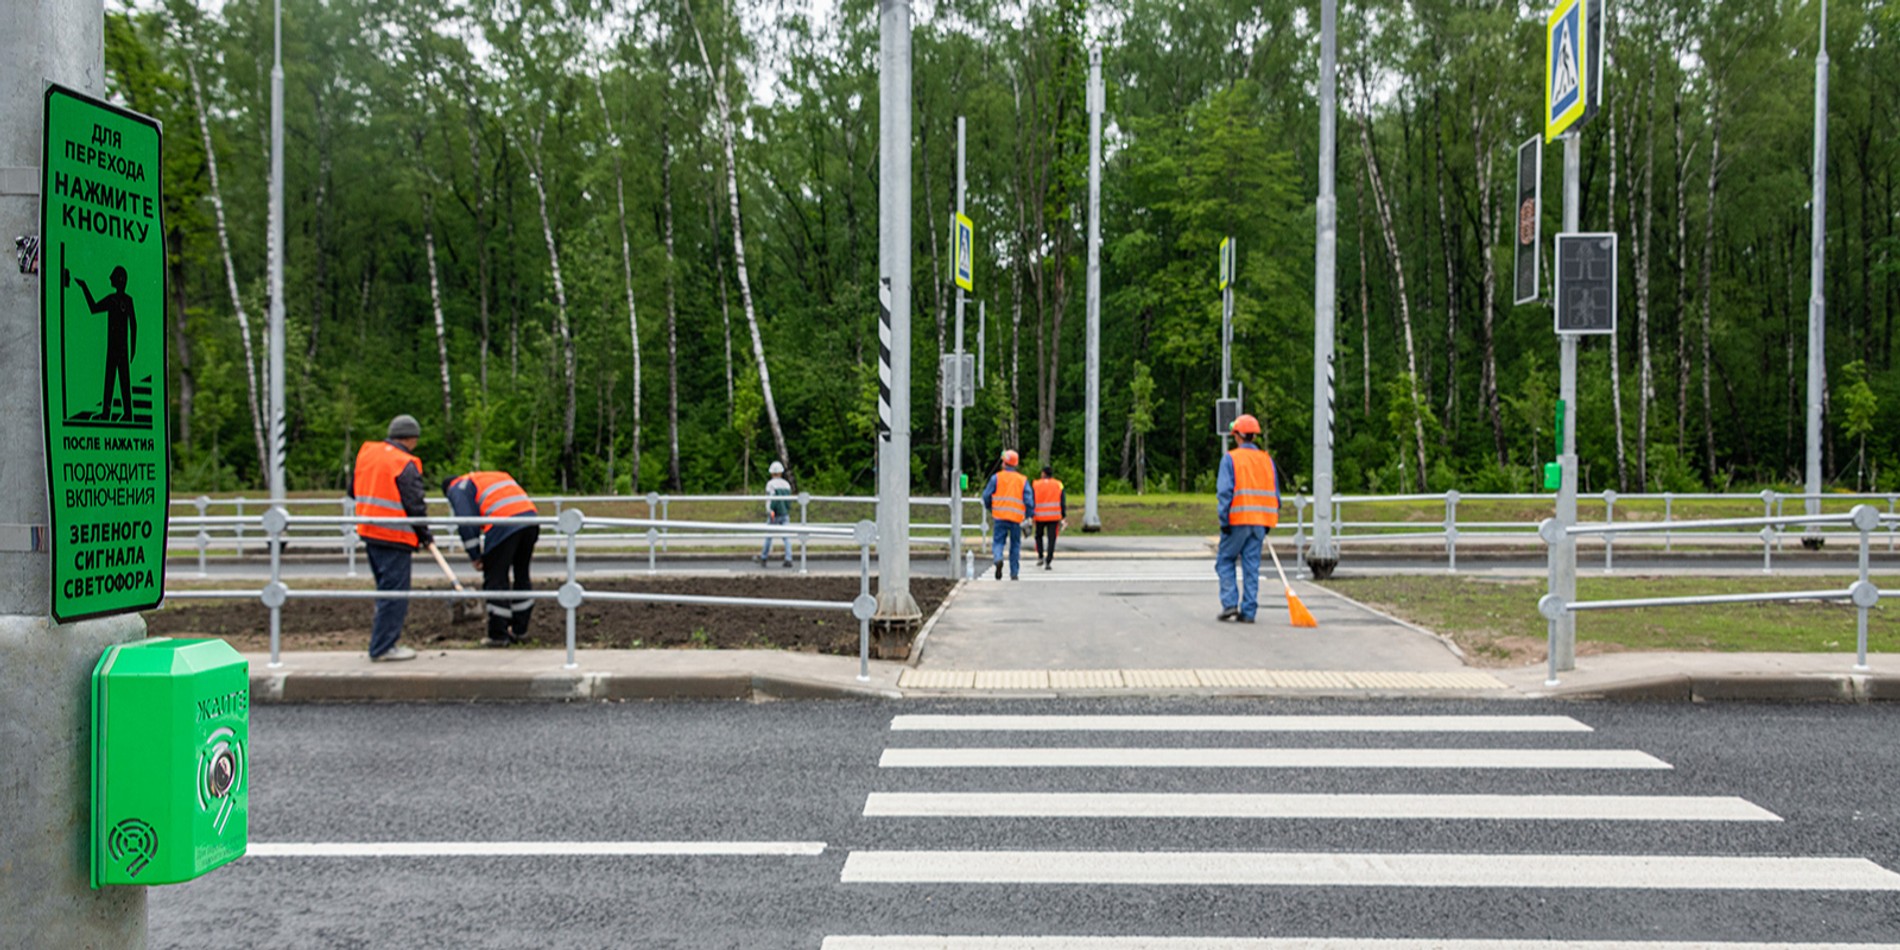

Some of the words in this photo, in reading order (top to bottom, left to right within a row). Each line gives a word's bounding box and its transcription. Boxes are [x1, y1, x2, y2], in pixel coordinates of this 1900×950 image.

[92, 124, 122, 149] ДЛЯ
[65, 140, 145, 182] ПЕРЕХОДА
[54, 171, 154, 218] НАЖМИТЕ
[63, 203, 149, 243] КНОПКУ
[63, 436, 101, 450] ПОСЛЕ
[104, 437, 155, 451] НАЖАТИЯ
[63, 463, 156, 485] ПОДОЖДИТЕ
[66, 488, 155, 509] ВКЛЮЧЕНИЯ
[70, 521, 152, 544] ЗЕЛЕНОГО
[75, 546, 145, 571] СИГНАЛА
[64, 570, 154, 600] СВЕТОФОРА
[196, 689, 247, 722] ЖДИТЕ
